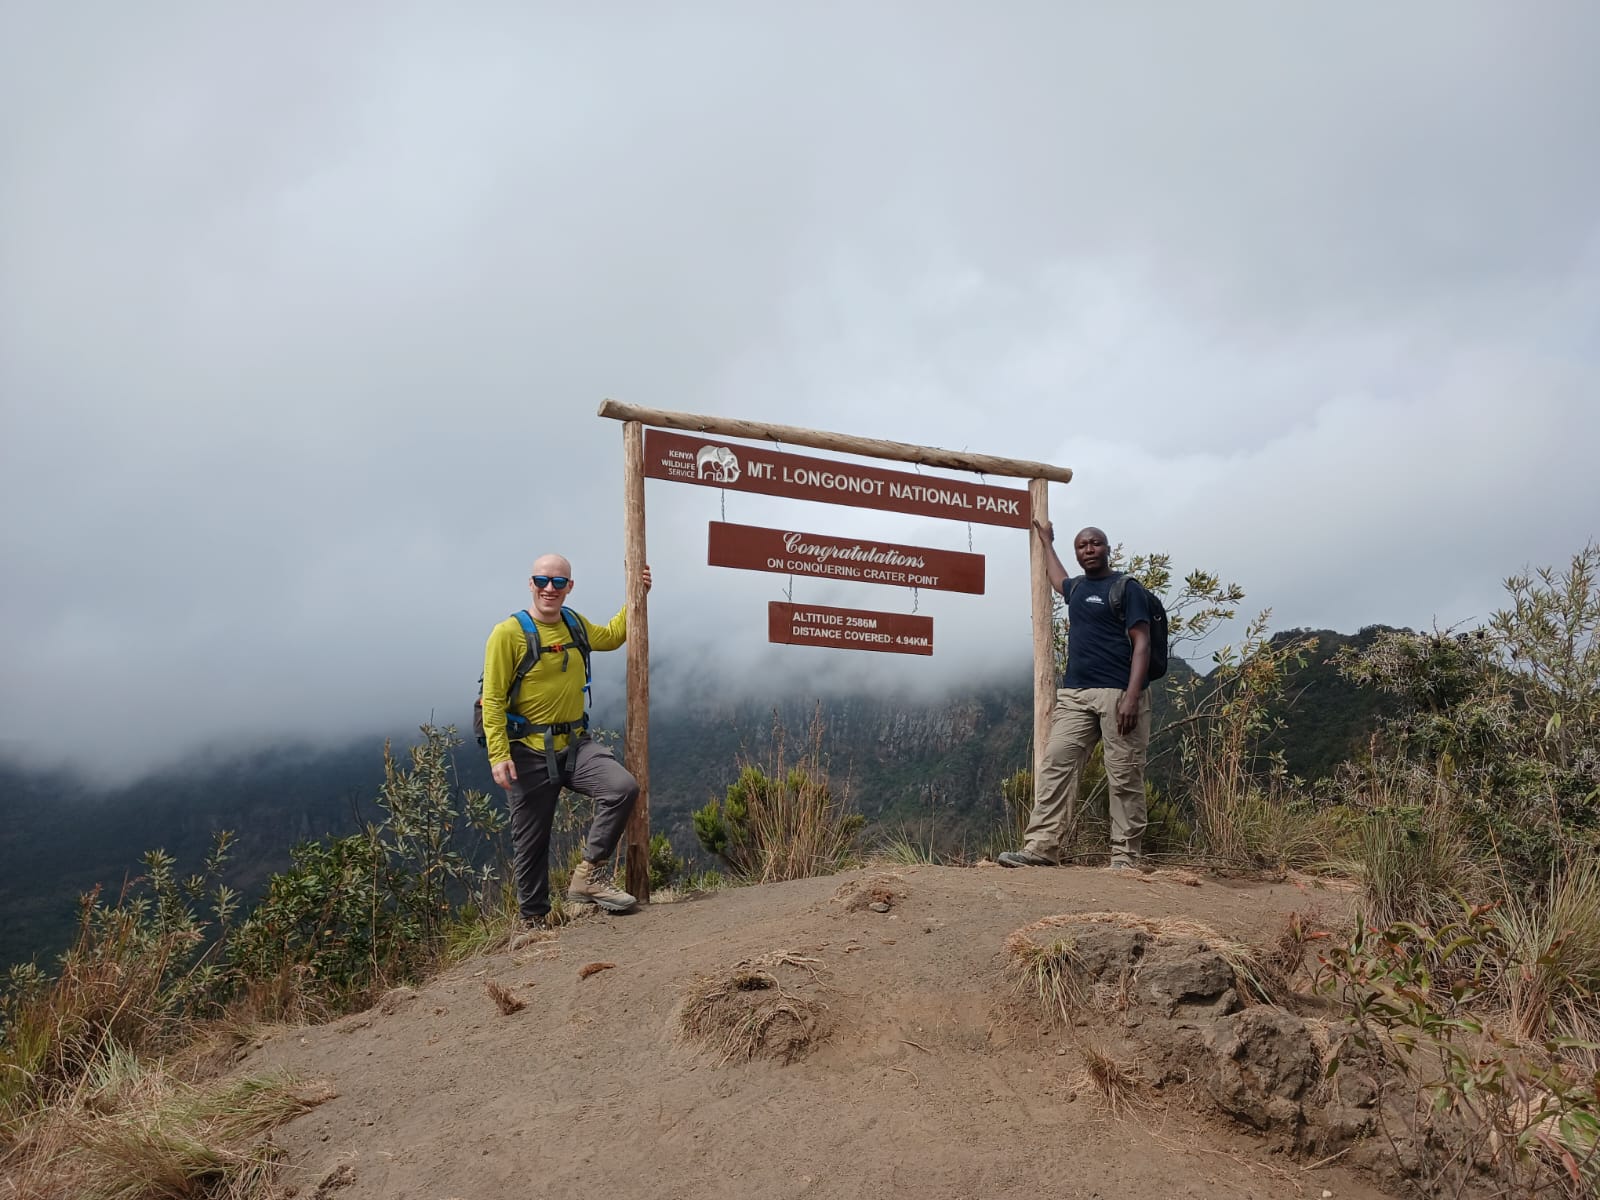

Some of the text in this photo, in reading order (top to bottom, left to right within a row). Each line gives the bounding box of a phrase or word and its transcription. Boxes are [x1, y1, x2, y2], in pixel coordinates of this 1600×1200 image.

[669, 450, 694, 460] KENYA
[661, 459, 696, 470] WILDLIFE
[668, 468, 695, 478] SERVICE
[747, 461, 1020, 515] MT. LONGONOT NATIONAL PARK
[783, 532, 925, 568] Congratulations
[767, 558, 939, 586] ON CONQUERING CRATER POINT
[792, 612, 844, 625] ALTITUDE
[792, 626, 841, 639] DISTANCE
[844, 631, 894, 644] COVERED:
